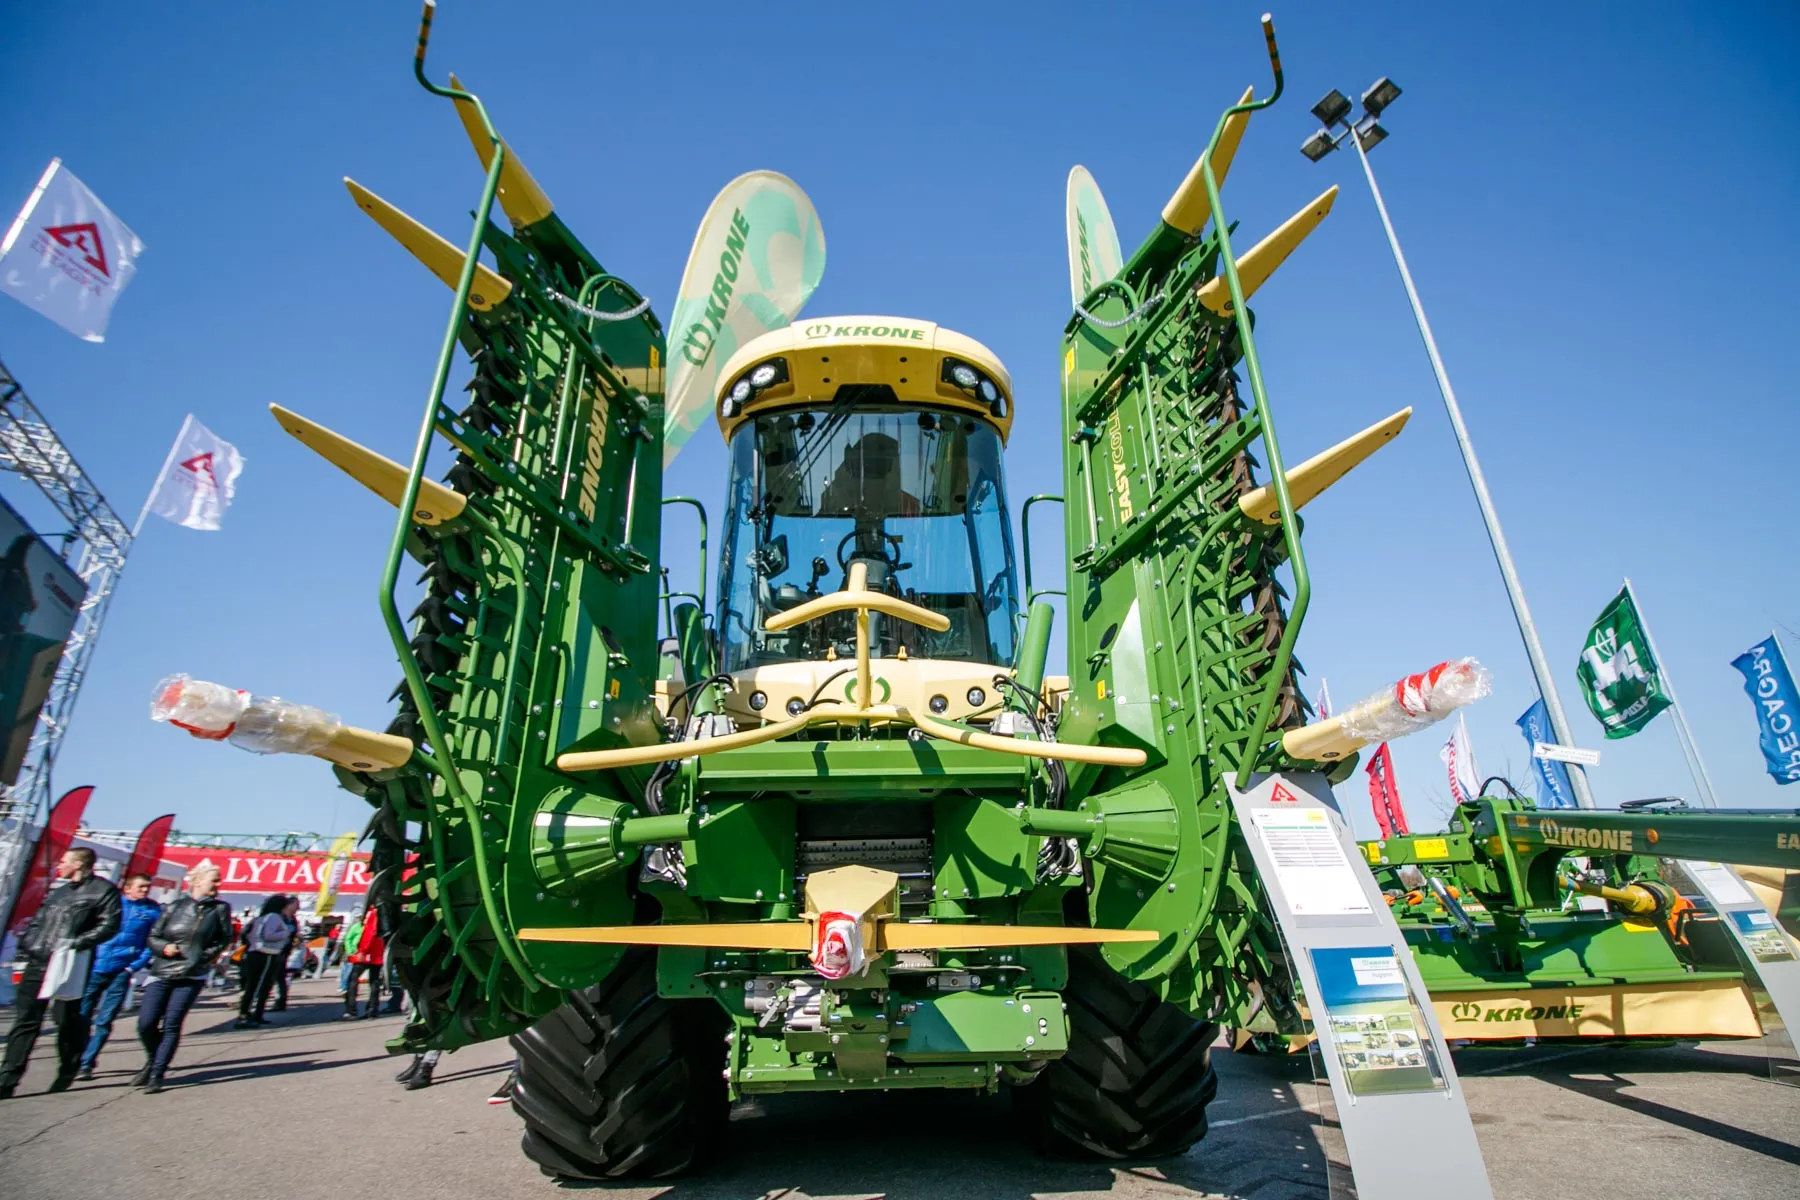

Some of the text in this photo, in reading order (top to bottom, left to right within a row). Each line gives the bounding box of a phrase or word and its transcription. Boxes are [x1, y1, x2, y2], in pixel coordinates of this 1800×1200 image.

[704, 206, 750, 335] KRONE
[1076, 205, 1092, 299] RONE
[834, 325, 926, 340] KRONE
[579, 384, 610, 524] KRONE
[1108, 401, 1133, 525] EASYCOLL
[1560, 827, 1633, 852] KRONE
[223, 857, 373, 886] LYTAR
[1484, 1004, 1585, 1023] KRONE
